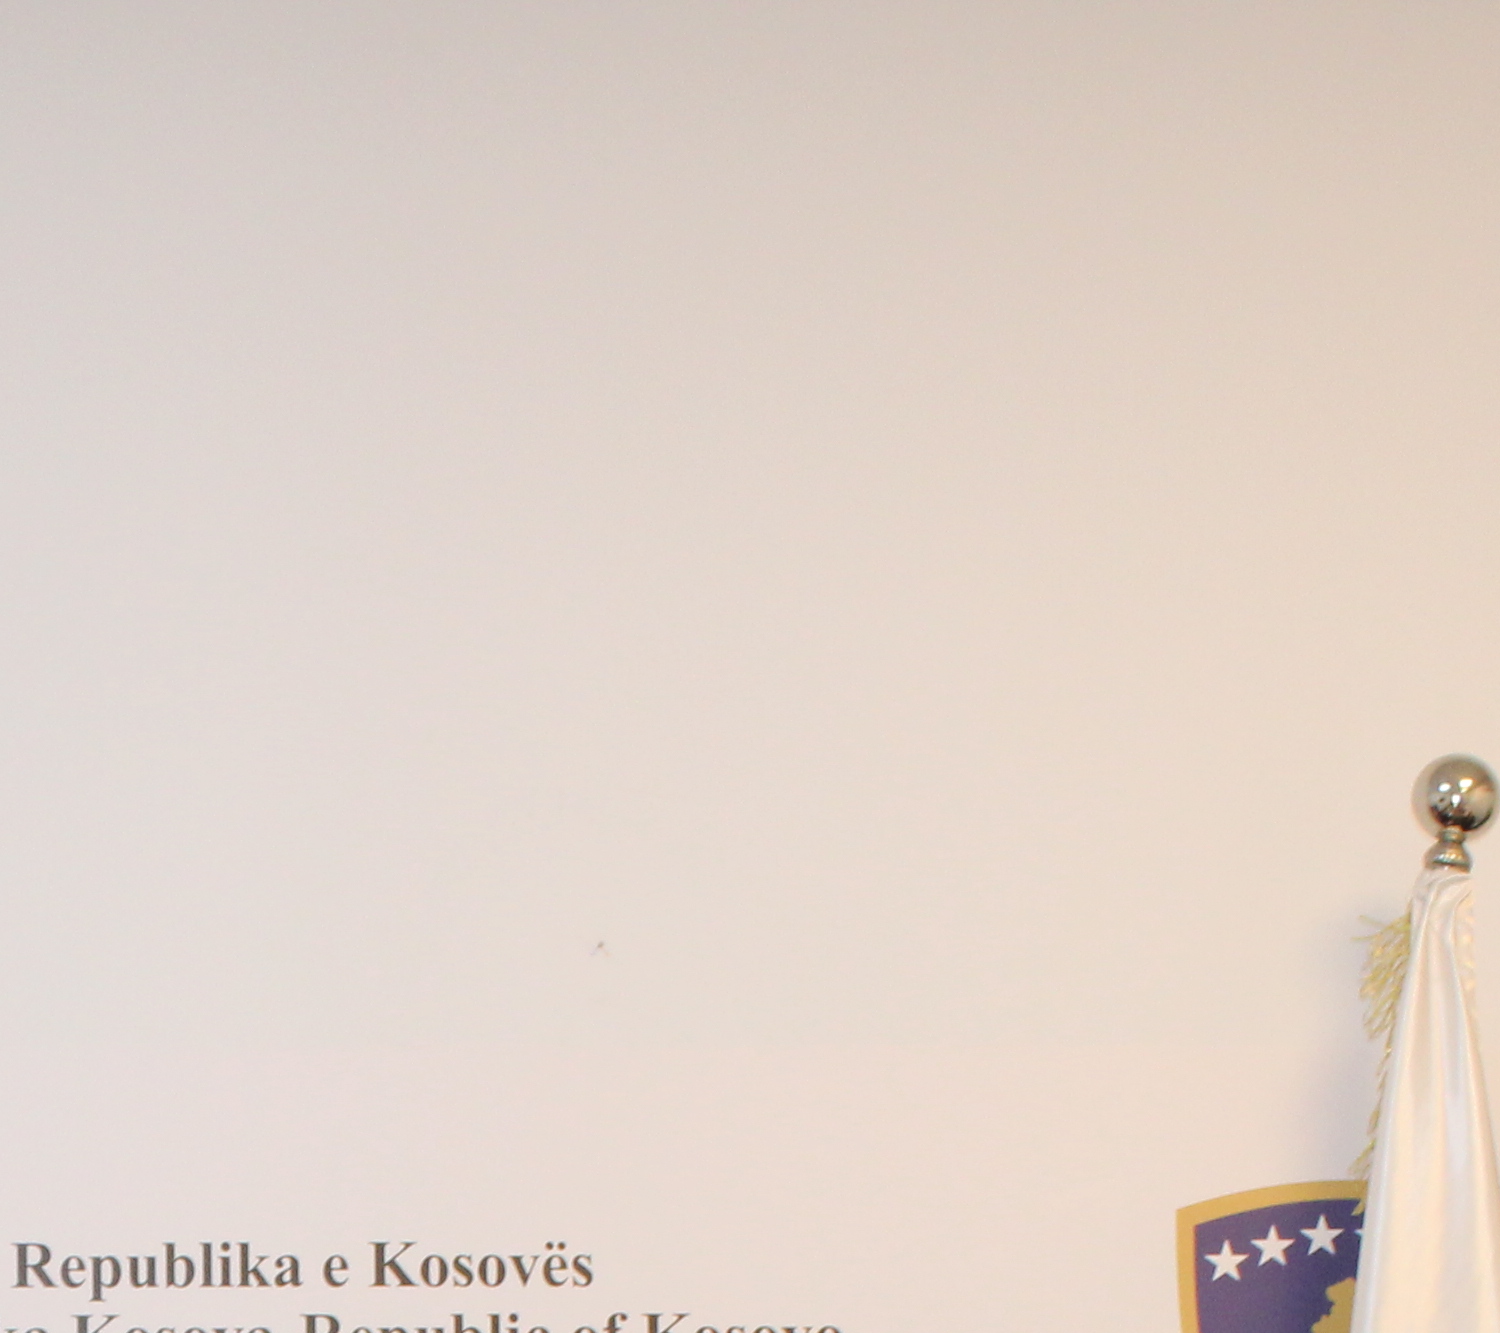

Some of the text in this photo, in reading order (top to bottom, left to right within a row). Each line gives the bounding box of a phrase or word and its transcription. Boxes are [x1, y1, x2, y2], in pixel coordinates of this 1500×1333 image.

[12, 1240, 595, 1301] Republika e Kosovës
